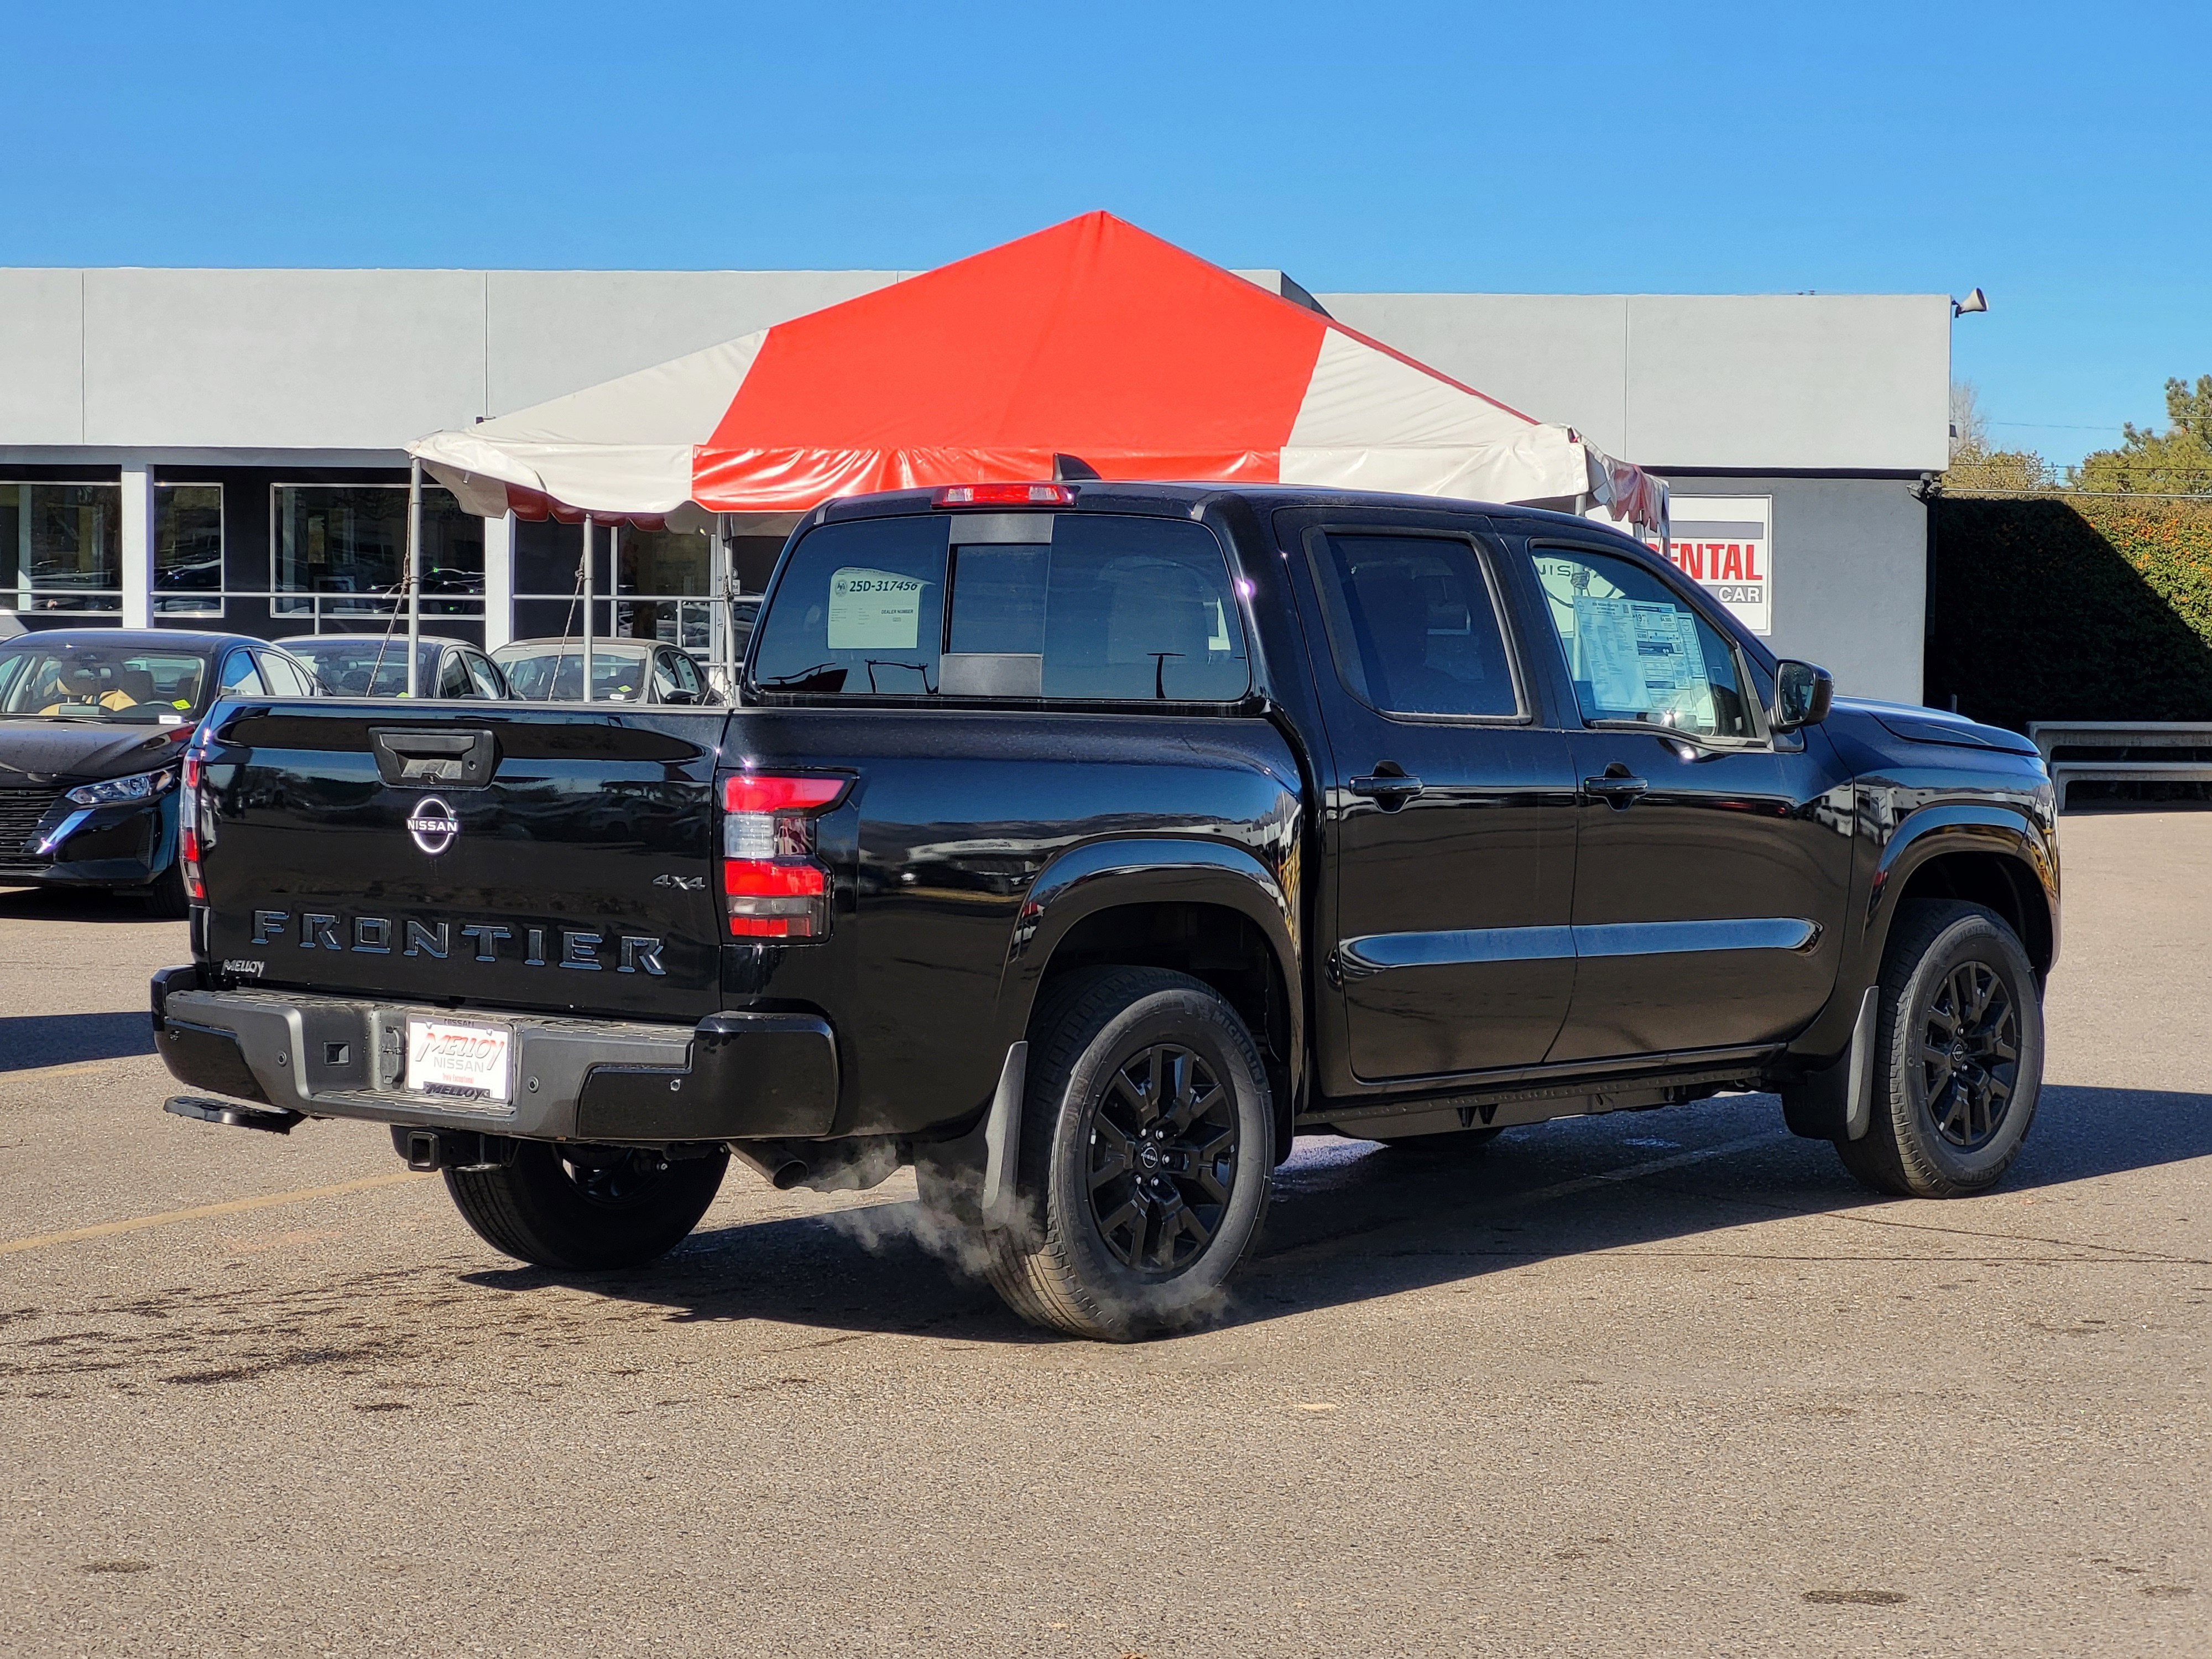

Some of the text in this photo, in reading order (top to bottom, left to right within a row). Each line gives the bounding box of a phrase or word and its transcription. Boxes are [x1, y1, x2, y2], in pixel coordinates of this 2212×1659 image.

[1646, 544, 1762, 580] NTAL
[849, 581, 920, 592] 25D-317456
[1718, 586, 1761, 603] CAR
[1635, 613, 1642, 622] 19
[408, 820, 457, 832] NISSAN
[251, 910, 666, 975] FRONTIER
[221, 959, 264, 977] MELLOY
[444, 1019, 474, 1027] NISSAN
[415, 1032, 504, 1070] MELLOY
[434, 1057, 484, 1072] NISSAN
[426, 1083, 484, 1100] MELLOY
